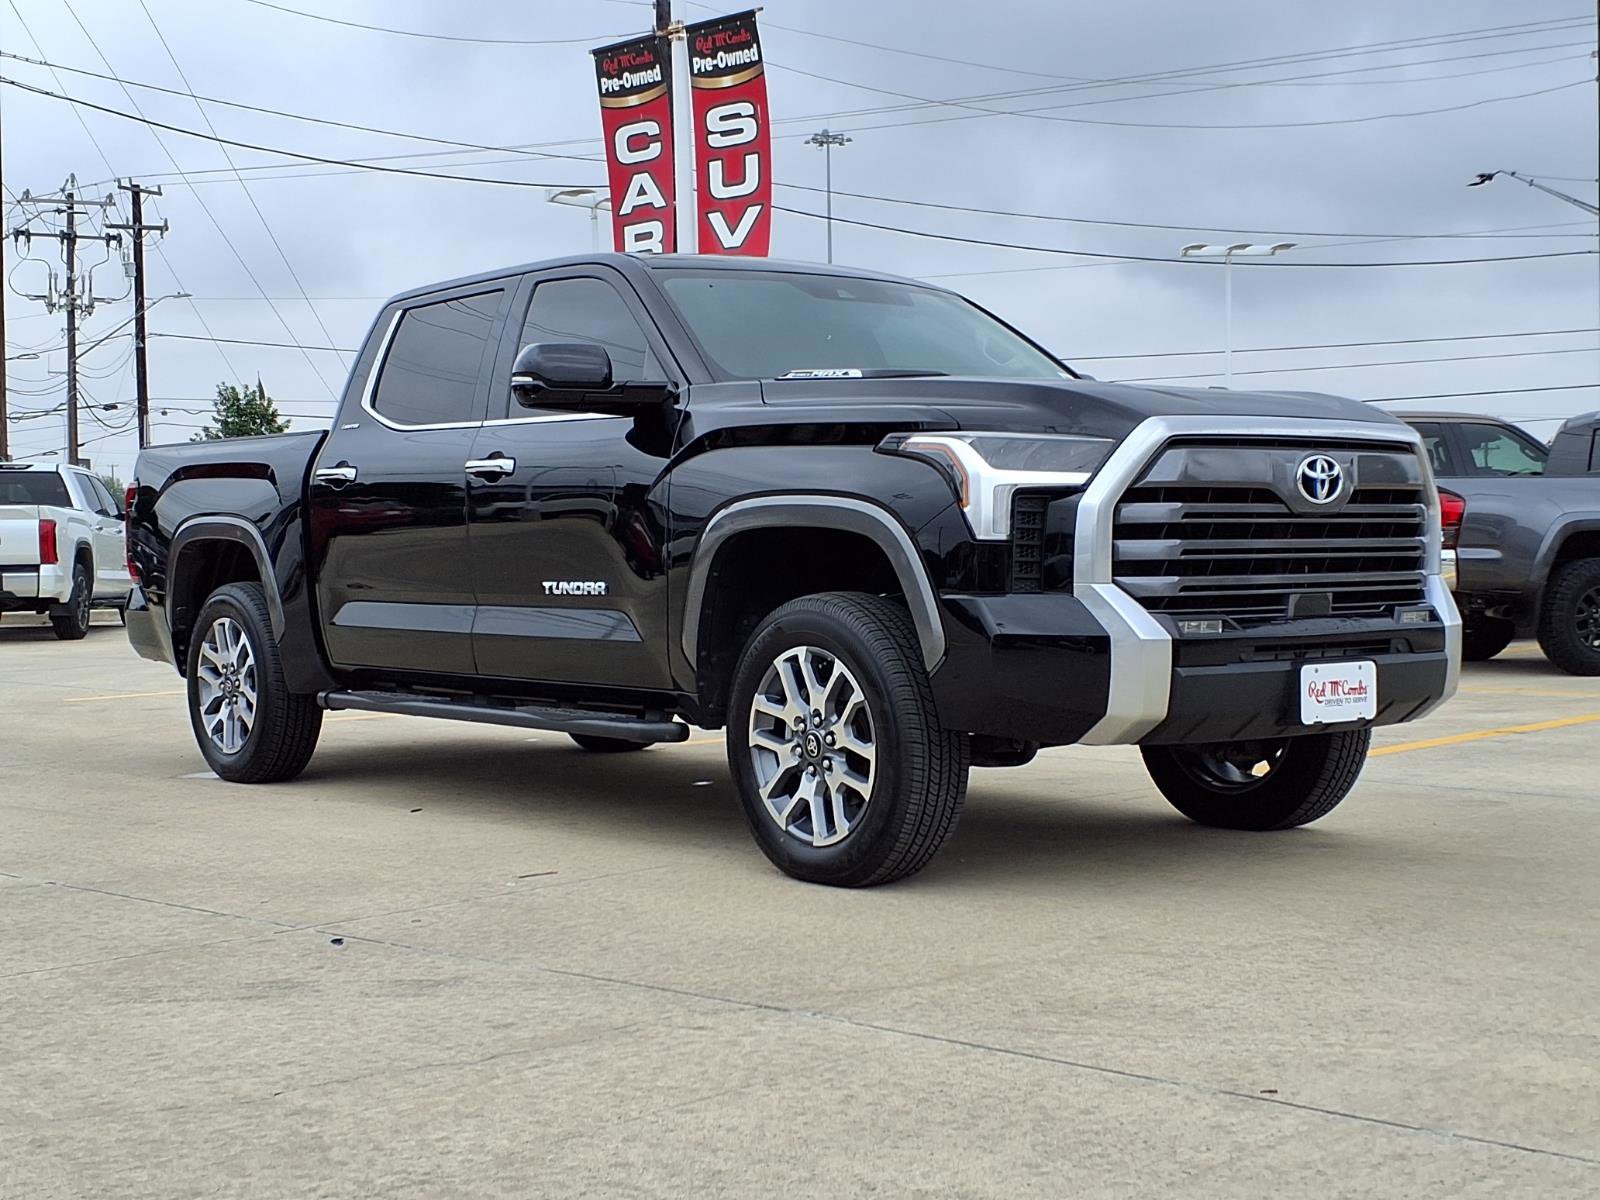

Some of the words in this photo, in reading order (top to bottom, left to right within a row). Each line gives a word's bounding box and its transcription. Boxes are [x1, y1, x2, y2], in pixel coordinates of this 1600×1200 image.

[695, 36, 713, 54] Red
[715, 29, 751, 47] McCombs
[602, 57, 619, 75] Red
[692, 43, 759, 74] Pre-Owned
[600, 64, 662, 94] Pre-Owned
[614, 120, 667, 253] CAR
[705, 101, 764, 249] SUV
[541, 581, 606, 595] TUNDRA
[1308, 681, 1326, 704] Red
[1328, 680, 1368, 696] McCombs
